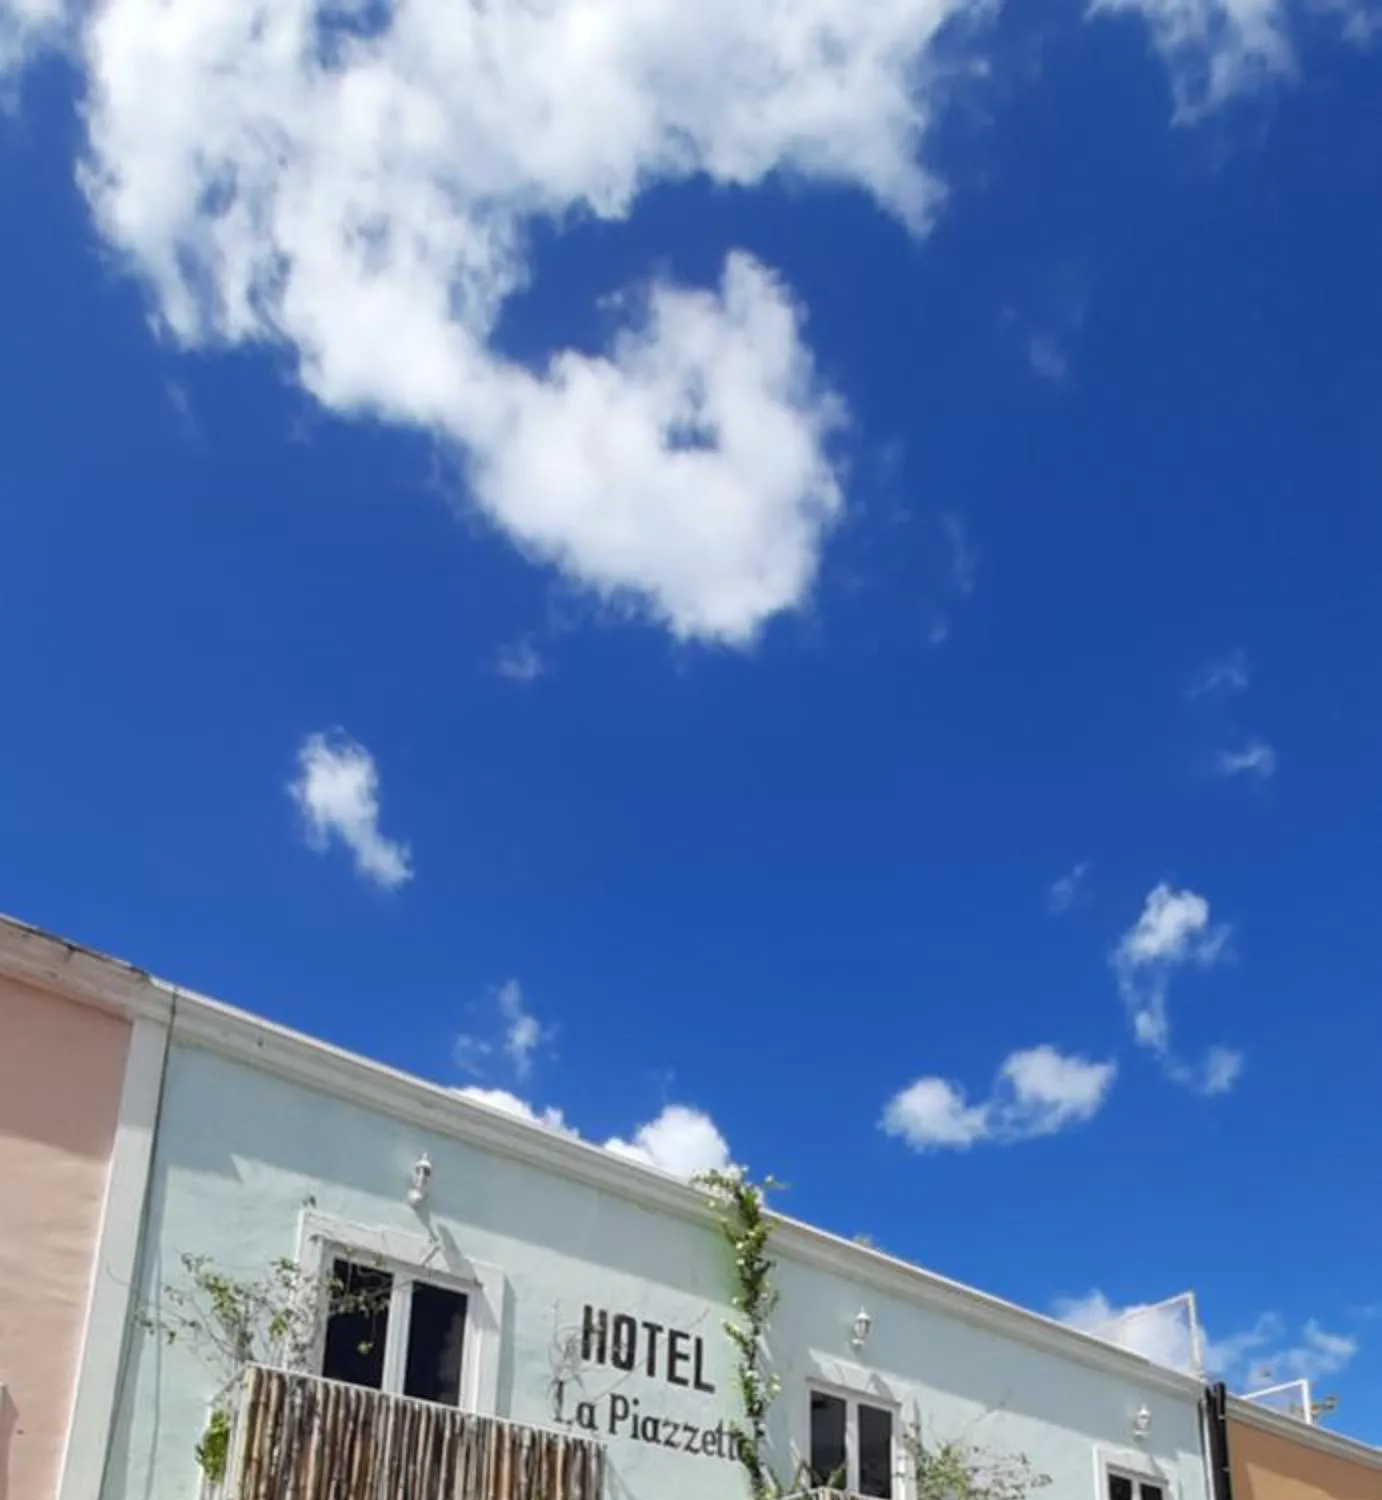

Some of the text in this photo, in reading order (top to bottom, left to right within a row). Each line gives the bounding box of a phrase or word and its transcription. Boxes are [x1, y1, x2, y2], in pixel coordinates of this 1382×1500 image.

[581, 1304, 715, 1393] HOTEL
[553, 1379, 747, 1461] La Piazzett
